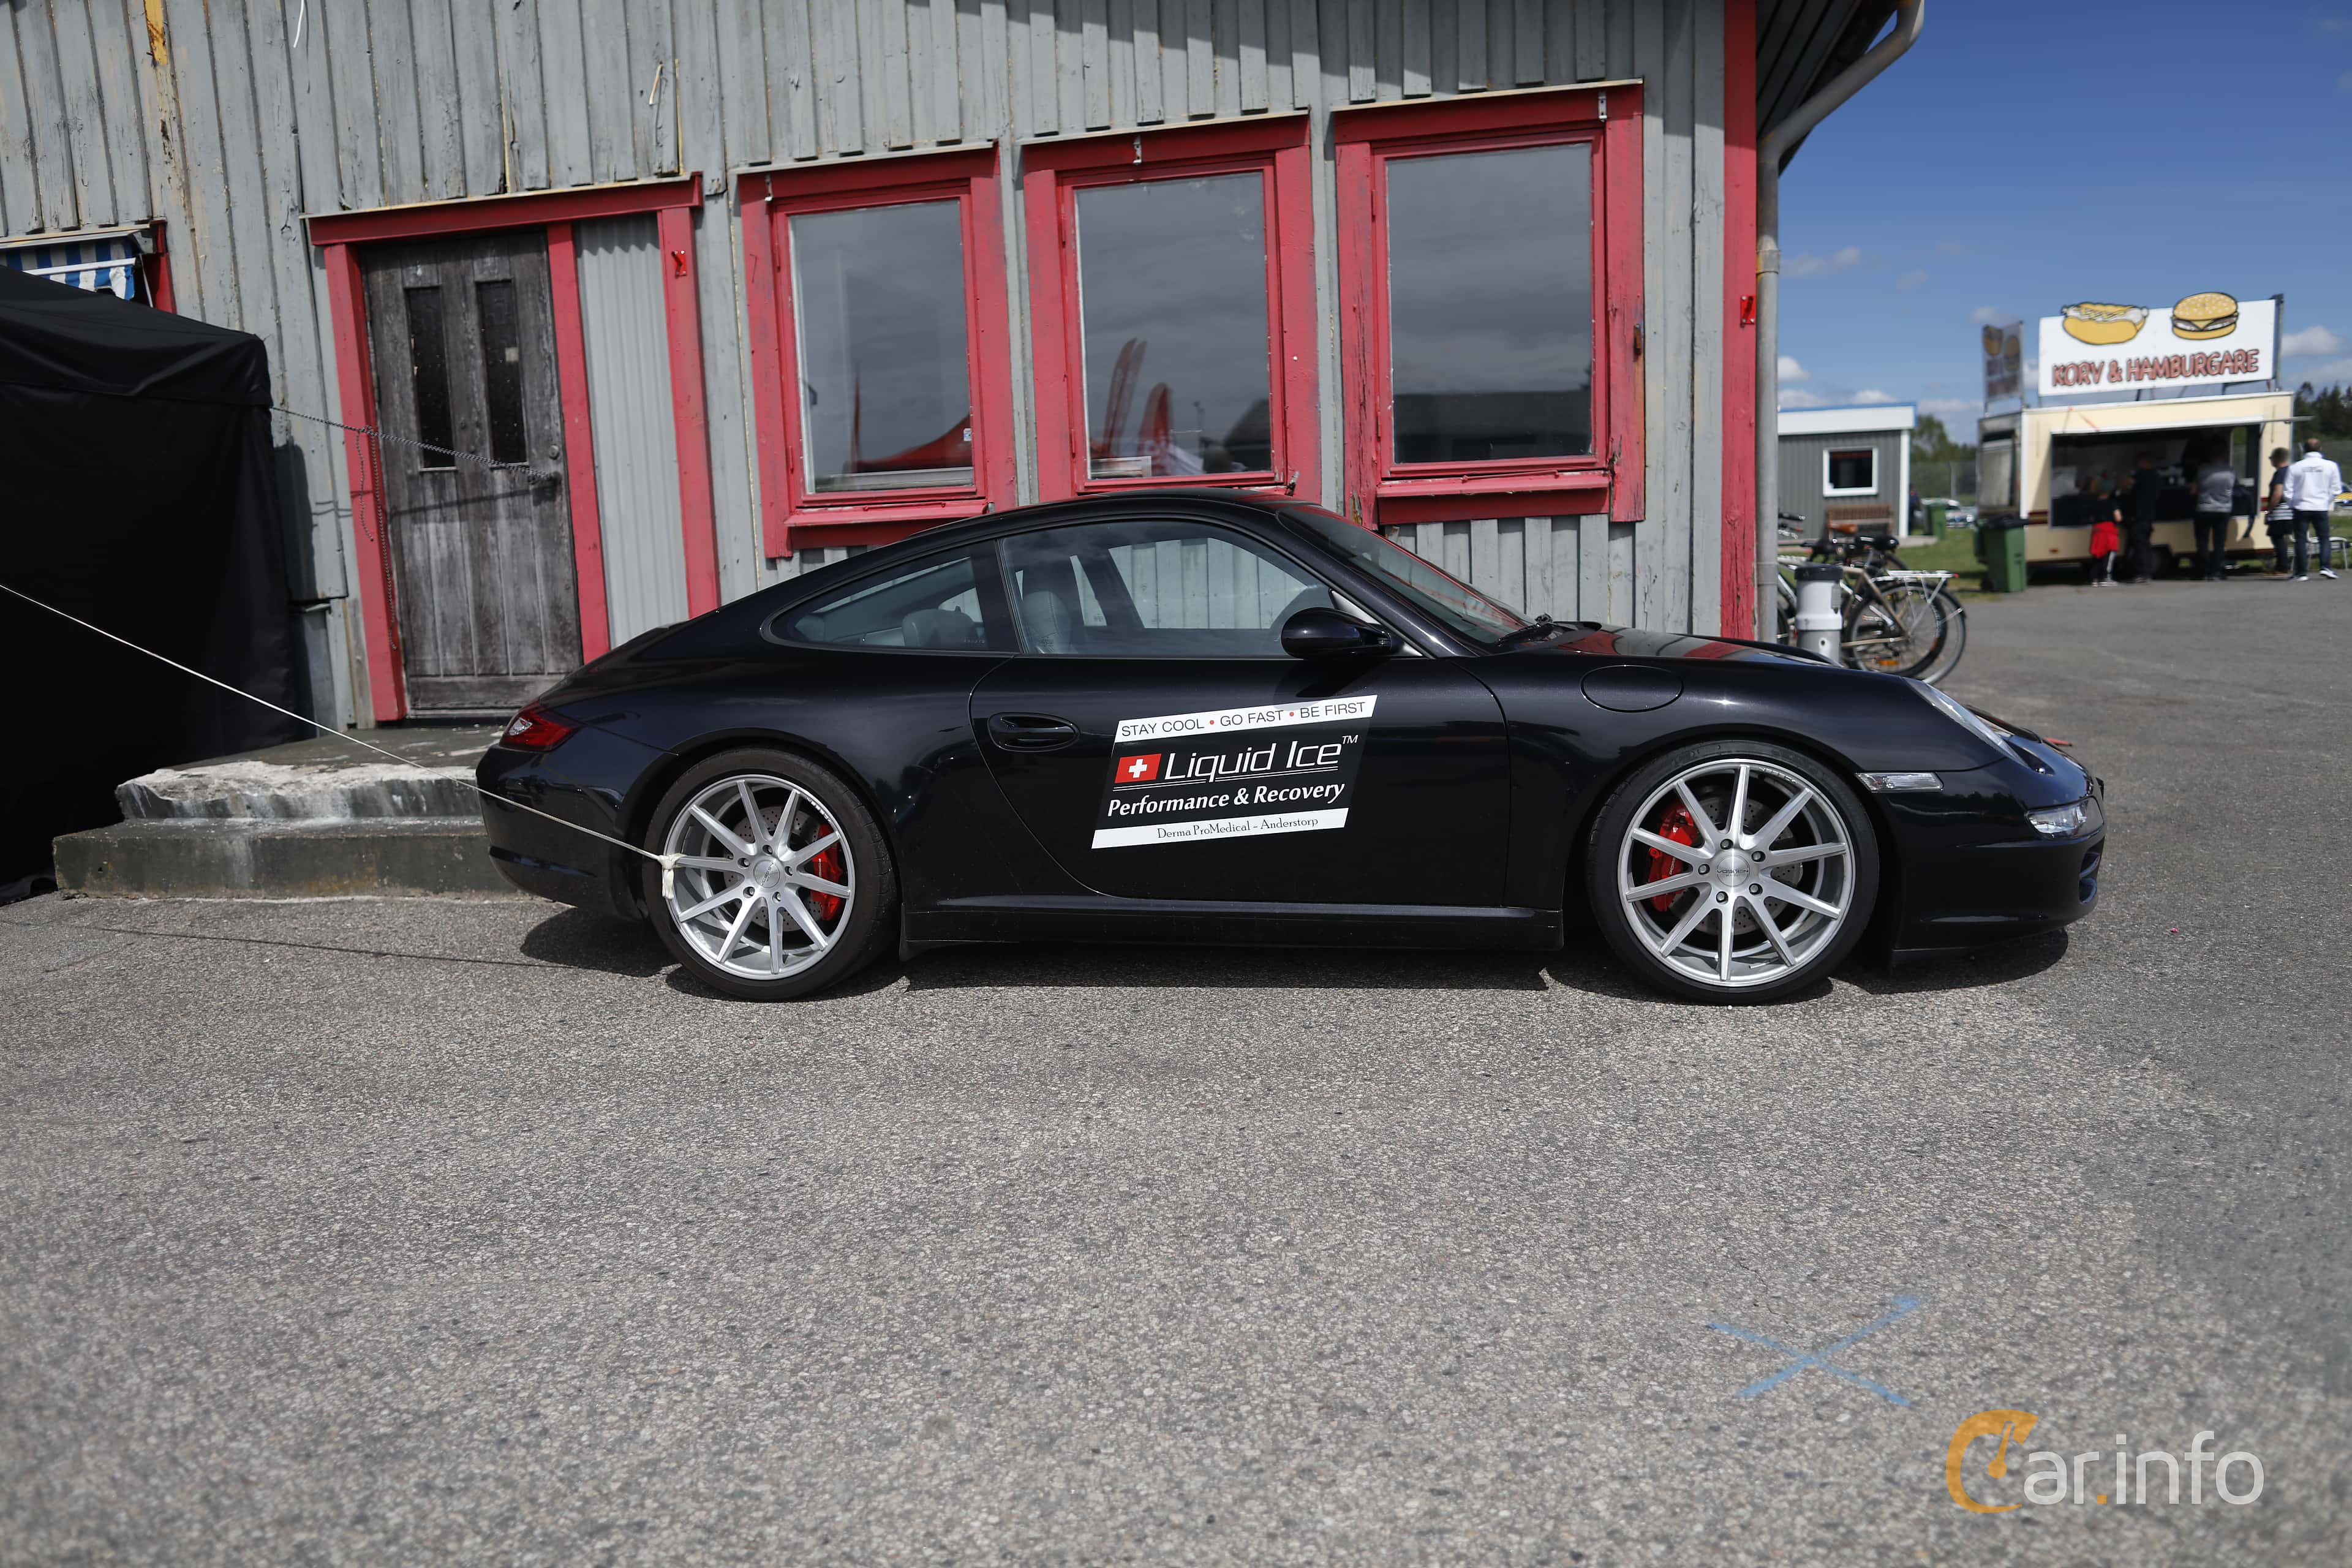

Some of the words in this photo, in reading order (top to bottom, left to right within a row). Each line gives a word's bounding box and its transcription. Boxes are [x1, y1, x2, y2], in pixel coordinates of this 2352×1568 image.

[2052, 360, 2105, 386] KORV
[2108, 360, 2122, 383] &
[2127, 349, 2260, 381] HAMBURGARE
[1121, 723, 1157, 737] STAY
[1162, 718, 1205, 733] COOL
[1220, 714, 1243, 726] GO
[1248, 710, 1284, 724] FAST
[1300, 707, 1320, 718] BE
[1325, 702, 1366, 716] FIRST
[1164, 742, 1276, 783] Liquid
[1107, 794, 1230, 817] Performance
[1234, 788, 1250, 805] &
[1254, 783, 1345, 804] Recovery
[1158, 827, 1191, 839] Derma
[1193, 819, 1251, 835] ProMedical
[1260, 817, 1319, 830] Anderstorp
